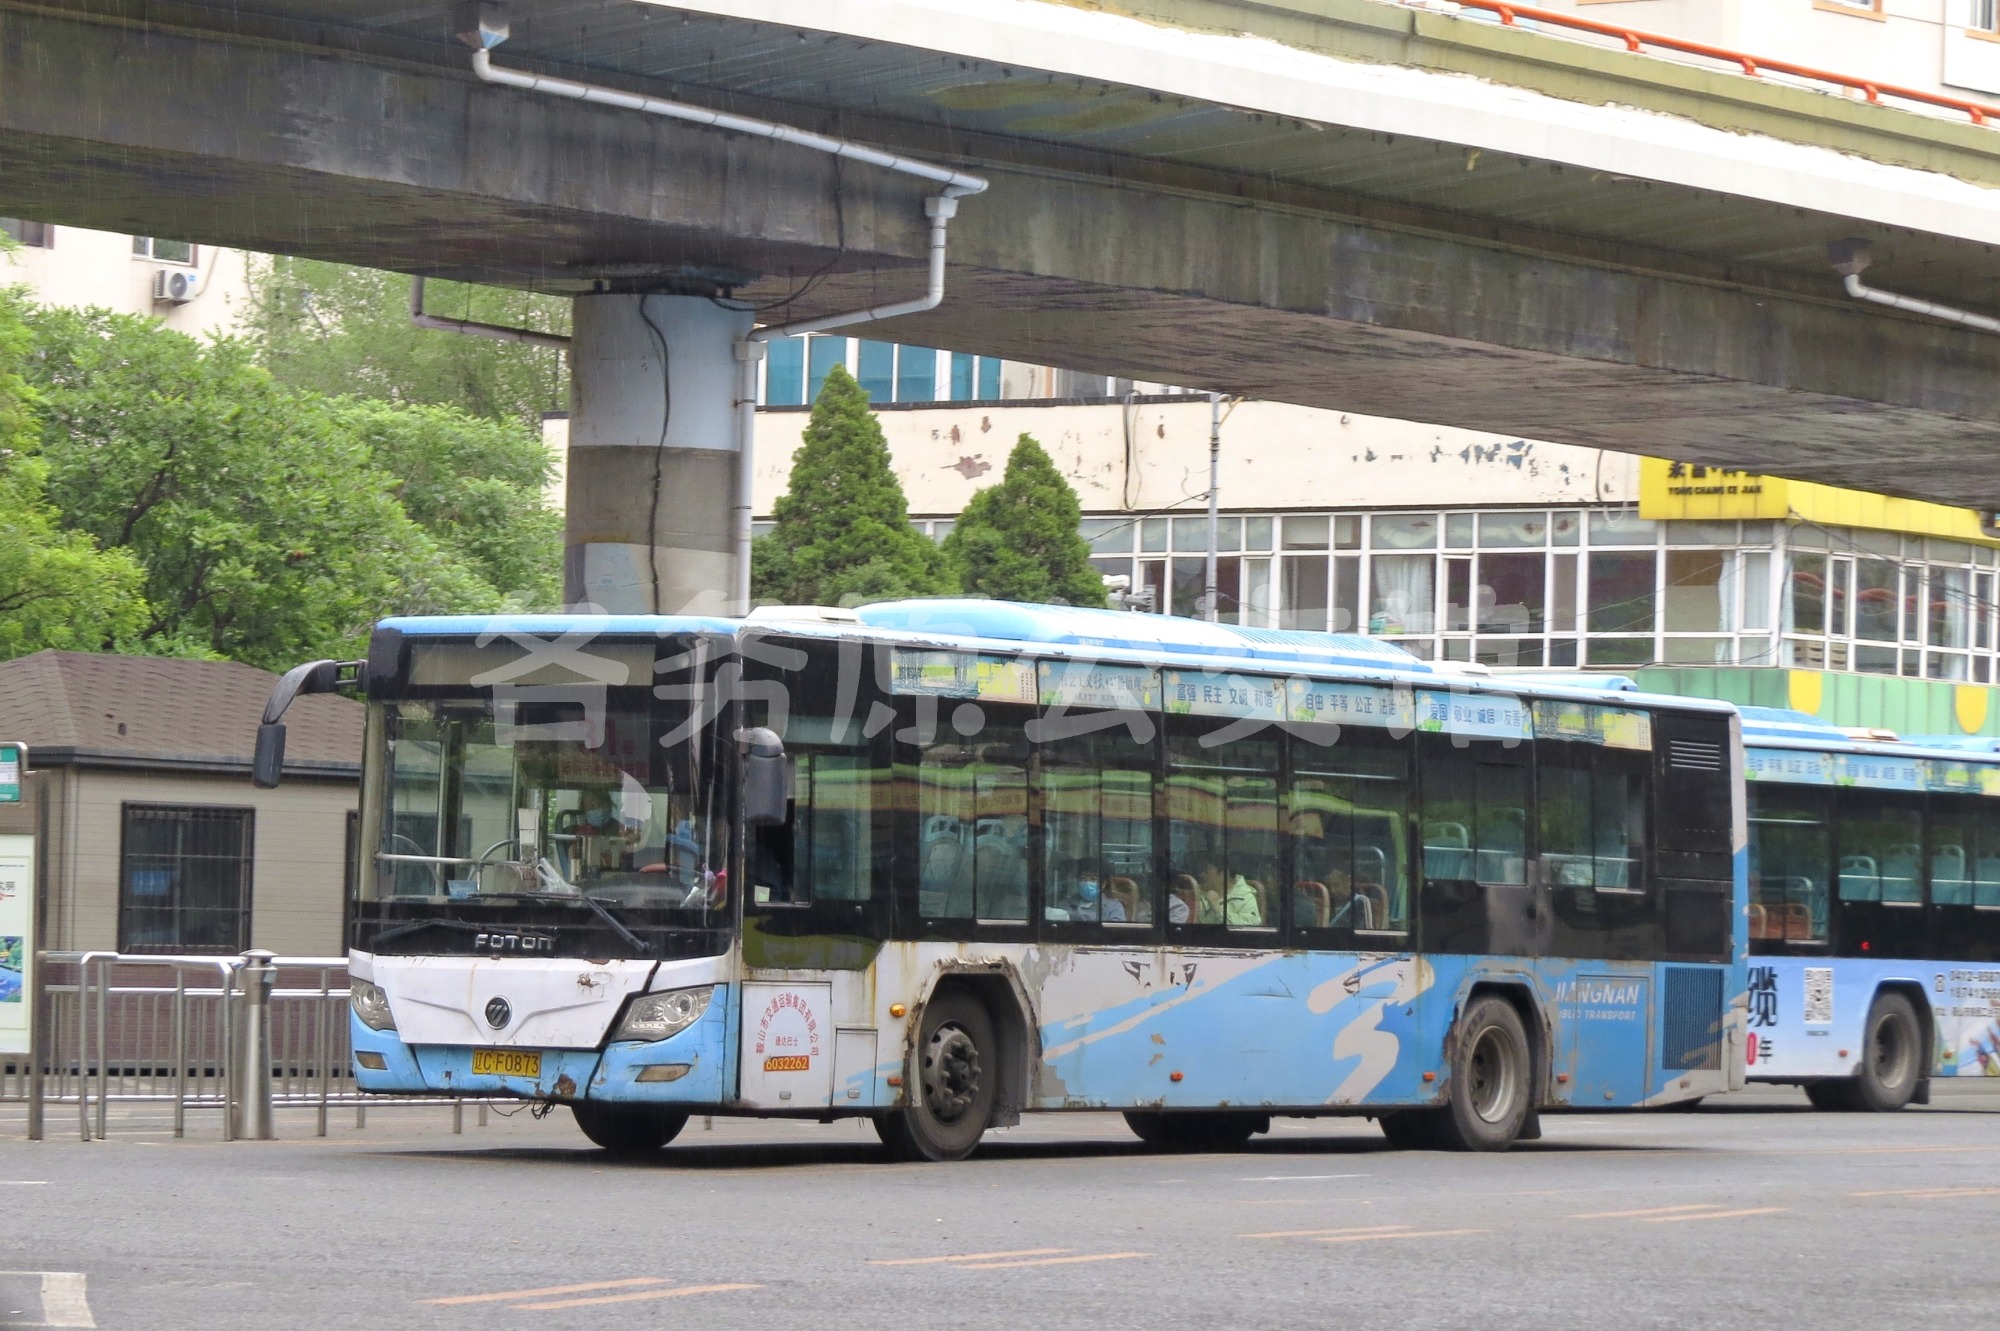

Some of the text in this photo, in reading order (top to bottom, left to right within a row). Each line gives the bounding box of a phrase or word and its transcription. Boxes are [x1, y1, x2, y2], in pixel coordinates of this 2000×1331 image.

[1177, 684, 1273, 708] 富强 民主 文明 和谐
[1306, 693, 1397, 716] 自由 平等 公正 法治
[1430, 703, 1521, 727] 爱国 敬业 诚信 友善
[475, 934, 551, 950] FOTON
[1585, 1009, 1636, 1020] TRANSPORT
[774, 1035, 799, 1047] 通达巴士
[766, 1057, 808, 1070] 6032262
